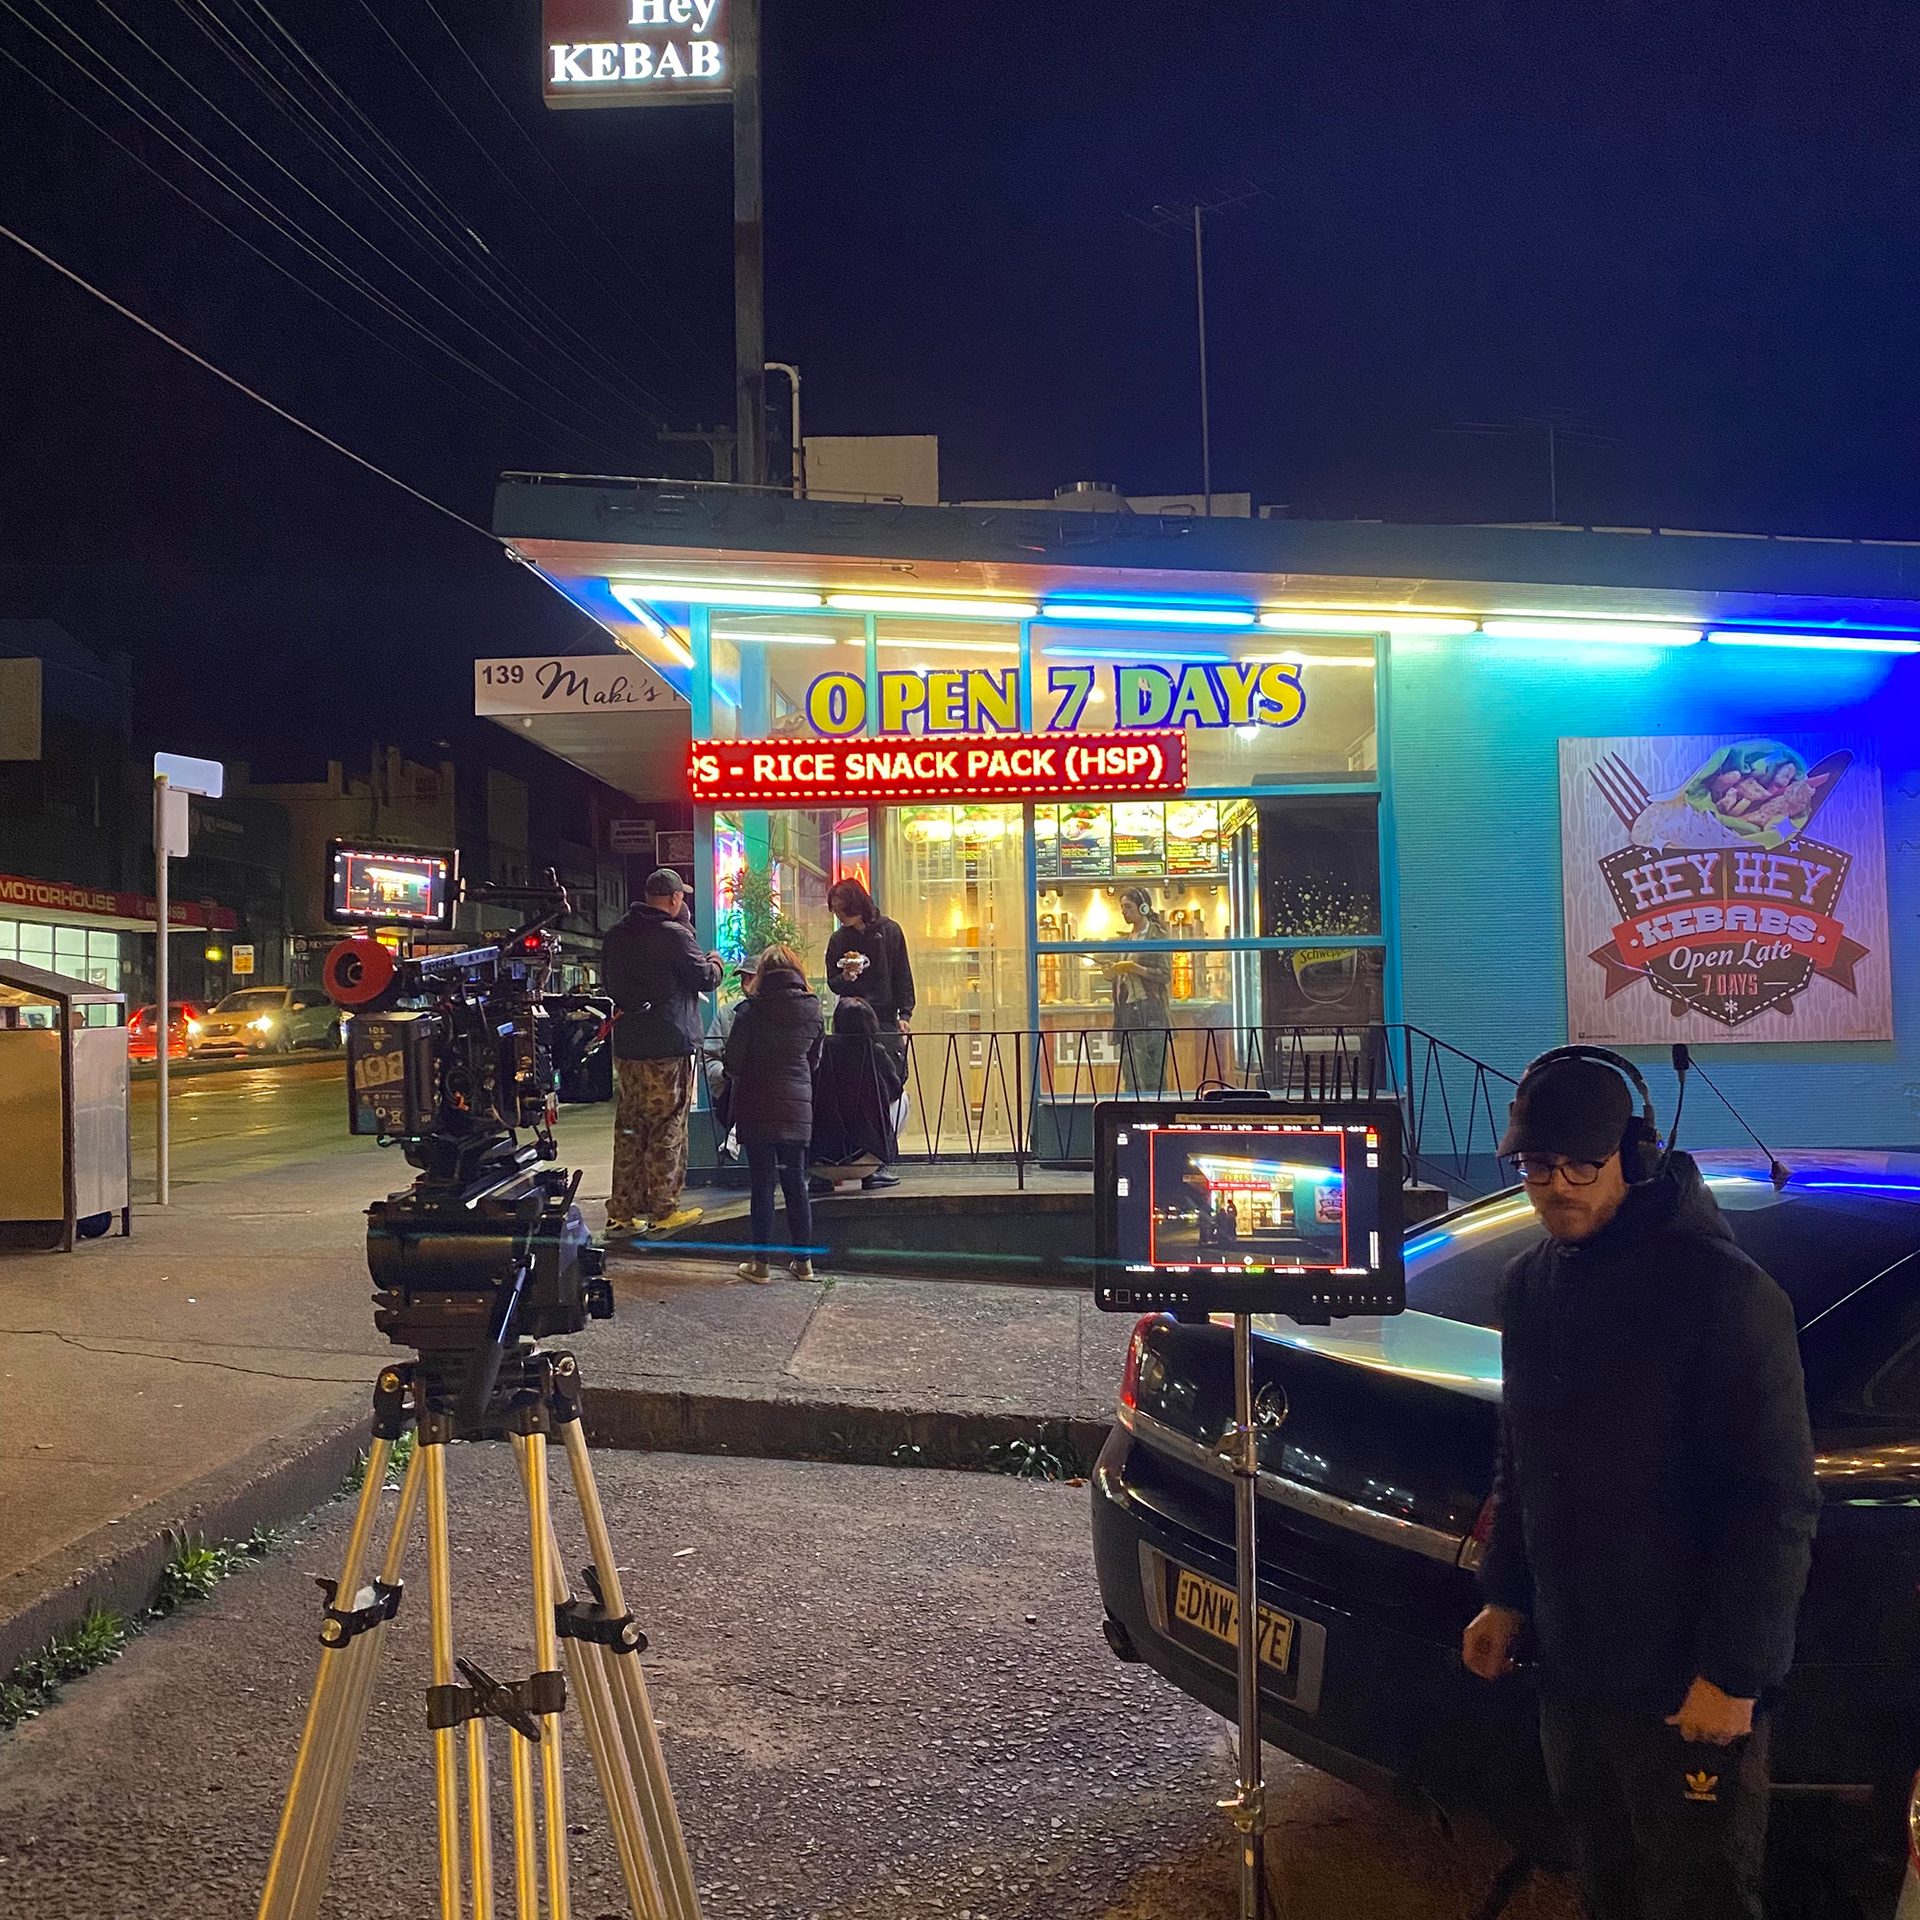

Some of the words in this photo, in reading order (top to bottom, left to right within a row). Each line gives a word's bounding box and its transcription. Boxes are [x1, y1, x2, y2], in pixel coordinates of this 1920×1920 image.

[627, 0, 718, 33] Hey
[549, 40, 721, 83] KEBAB
[482, 665, 524, 685] 139
[535, 661, 662, 706] Maki's
[805, 669, 1021, 738] OPEN
[1046, 664, 1095, 731] 7
[1112, 662, 1306, 730] DAYS
[753, 753, 836, 783] RICE
[845, 751, 959, 781] SNACK
[967, 747, 1056, 778] PACK
[1064, 744, 1163, 783] (HSP)
[0, 880, 118, 913] MOTORHOUSE
[1622, 852, 1720, 910] HEY
[1734, 851, 1833, 905] HEY
[1635, 905, 1818, 948] KEBABS
[1668, 945, 1734, 978] Open
[1738, 938, 1793, 969] Late
[1702, 974, 1713, 997] 7
[1717, 973, 1759, 996] DAYS
